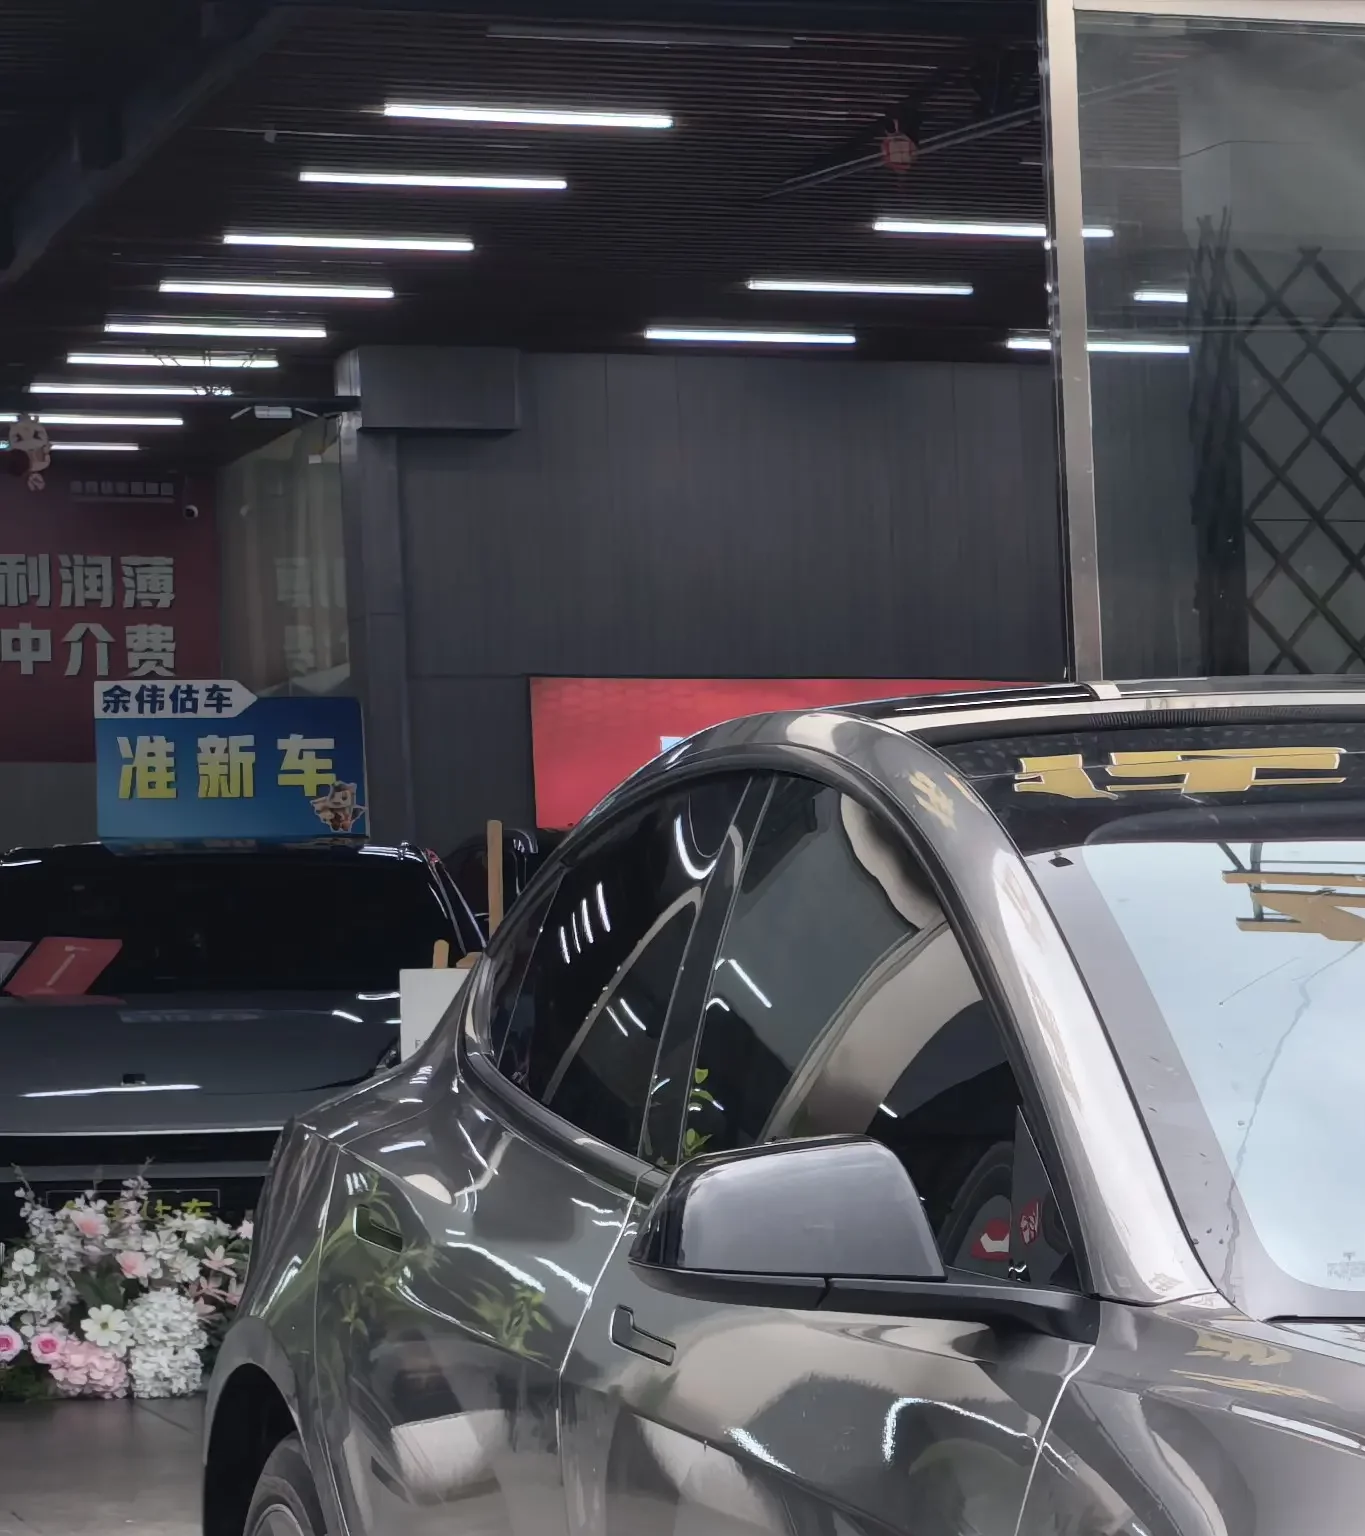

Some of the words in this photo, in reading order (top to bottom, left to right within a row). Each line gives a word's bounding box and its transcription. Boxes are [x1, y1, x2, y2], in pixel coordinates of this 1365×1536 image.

[0, 554, 175, 608] 利润薄
[1, 622, 176, 677] 中介费
[102, 684, 233, 714] 余伟估车
[117, 734, 336, 798] 准新车
